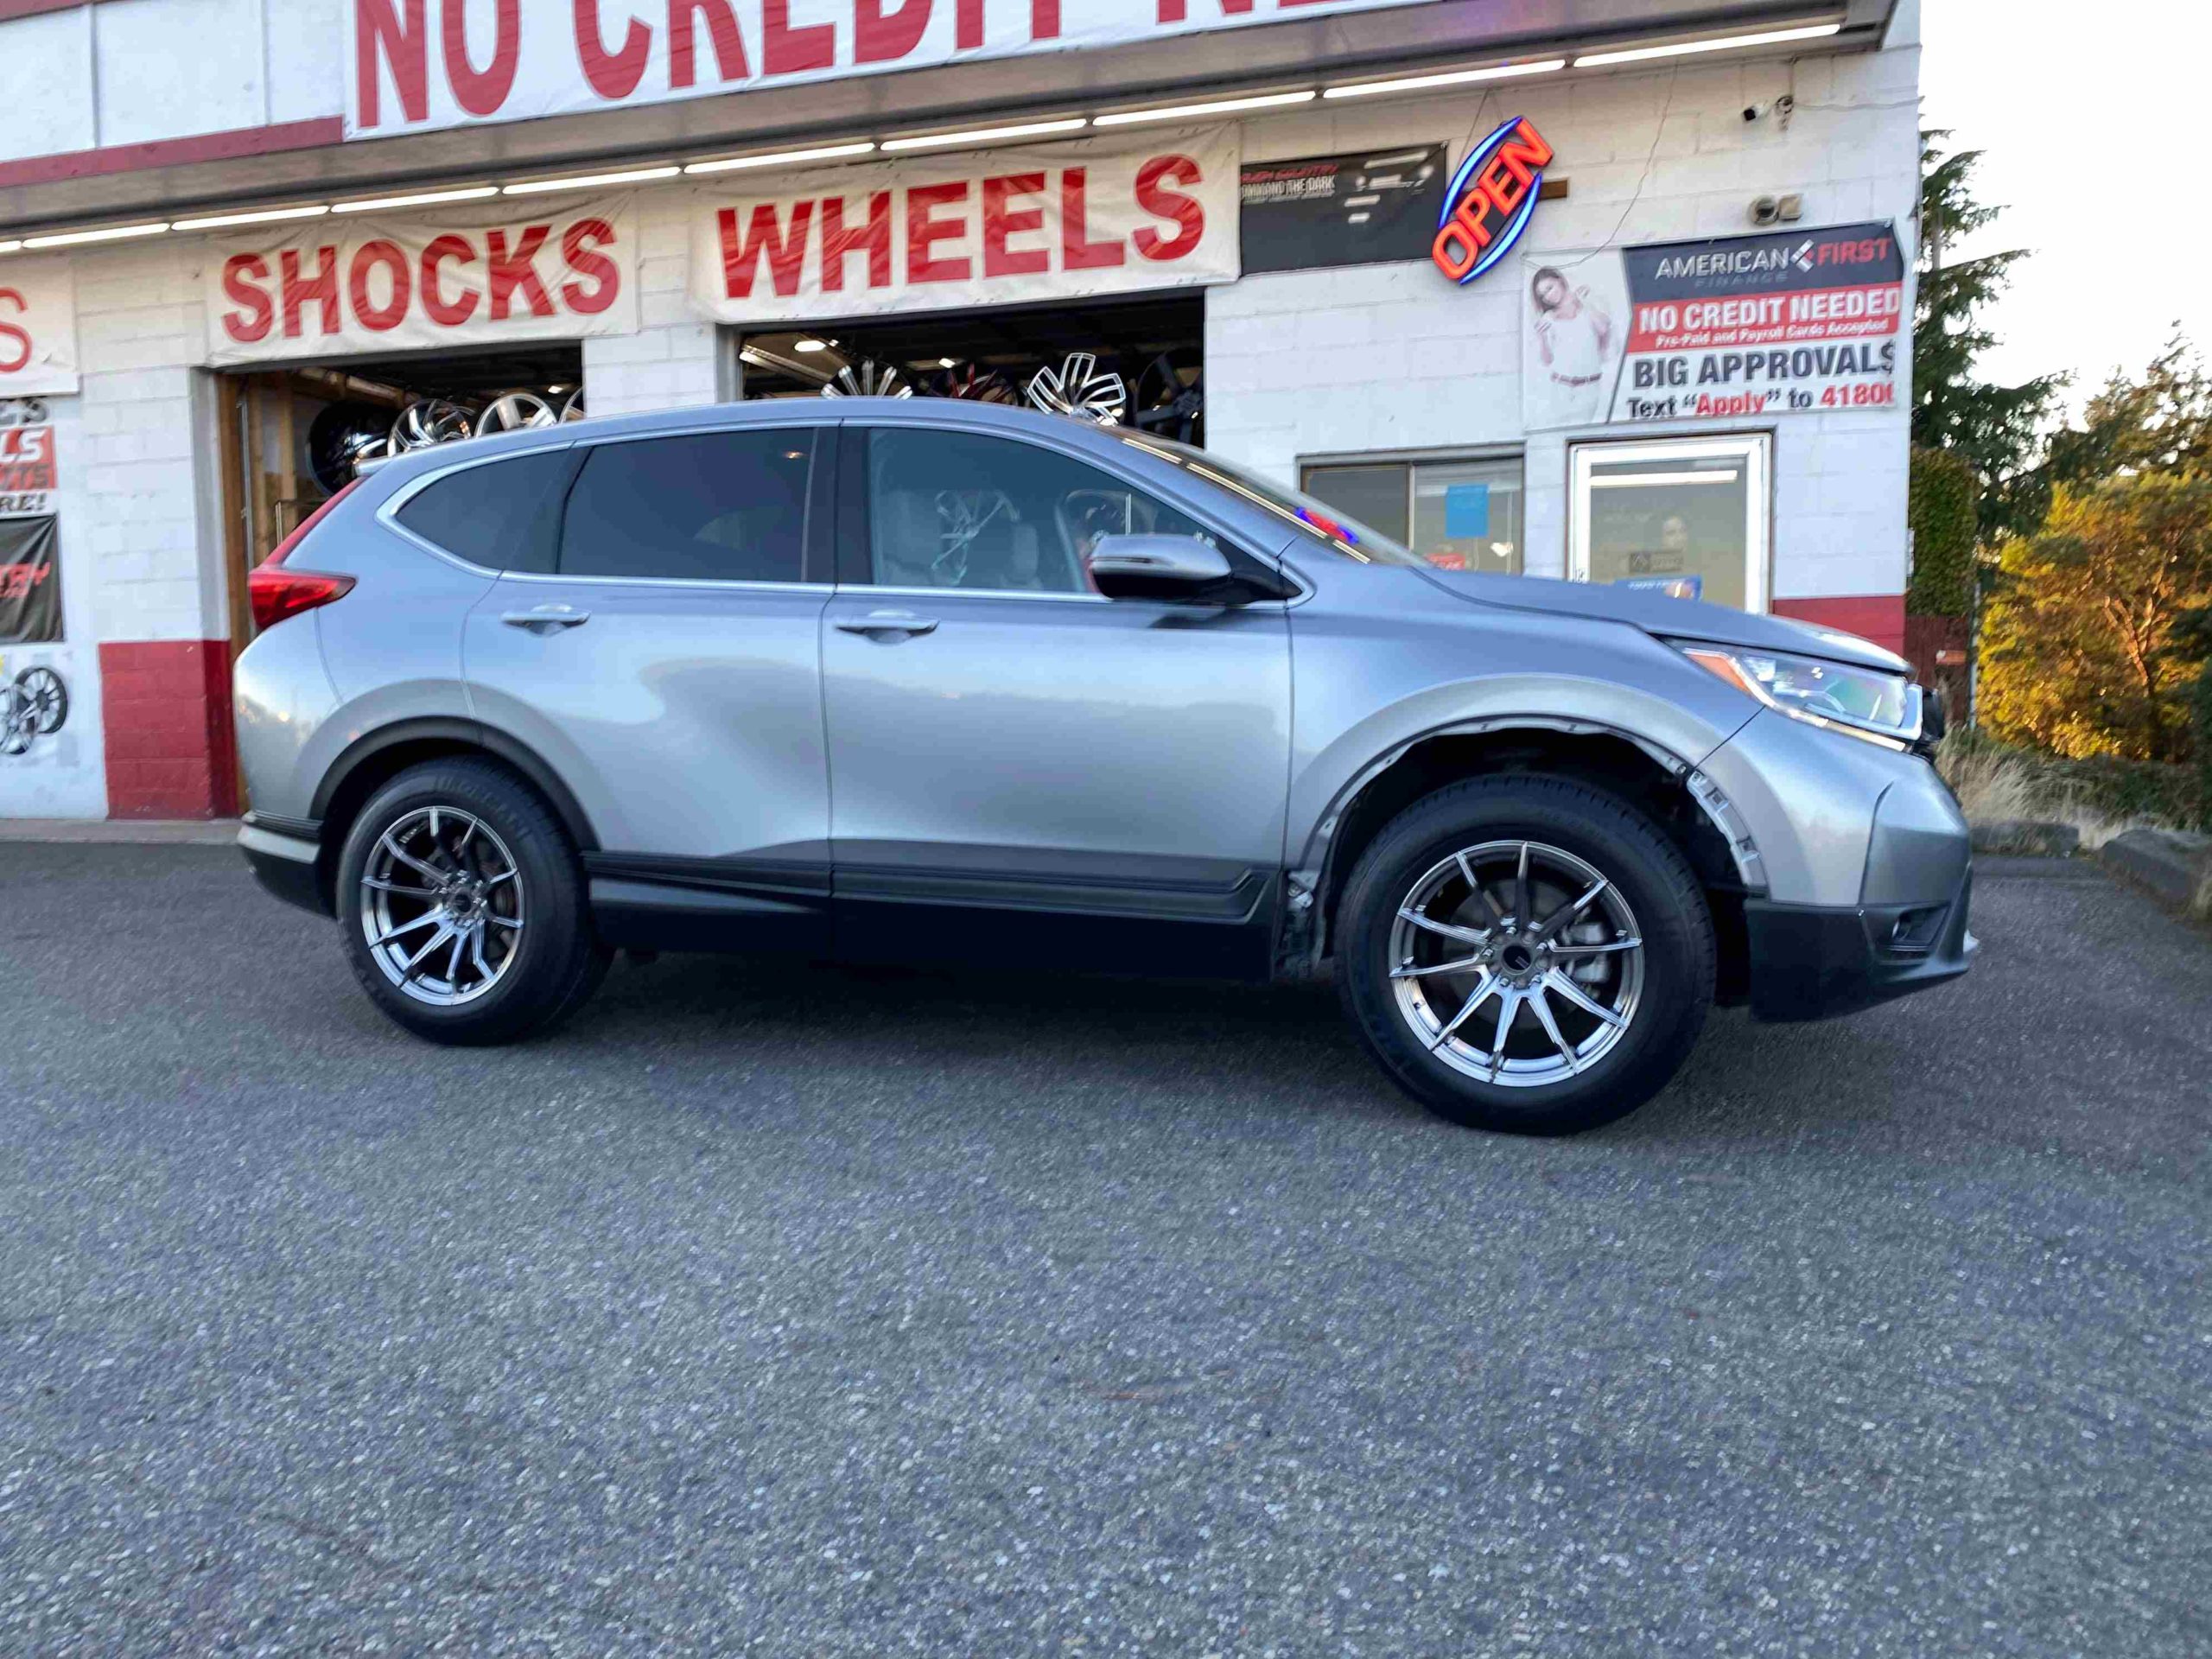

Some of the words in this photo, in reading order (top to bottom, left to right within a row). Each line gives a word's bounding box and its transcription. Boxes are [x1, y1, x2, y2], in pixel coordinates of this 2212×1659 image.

[355, 0, 522, 127] NO
[1306, 175, 1336, 194] DARK
[1432, 118, 1554, 279] OPEN
[716, 153, 1206, 299] WHEELS
[222, 217, 621, 343] SHOCKS
[1654, 247, 1789, 280] AMERICAN
[1817, 238, 1891, 265] FIRST
[1638, 305, 1678, 334] NO
[1684, 296, 1786, 330] CREDIT
[1790, 288, 1901, 323] NEEDED
[1713, 329, 1738, 344] and
[1633, 356, 1688, 390] BIG
[1627, 394, 1677, 419] Text
[1788, 388, 1814, 409] to
